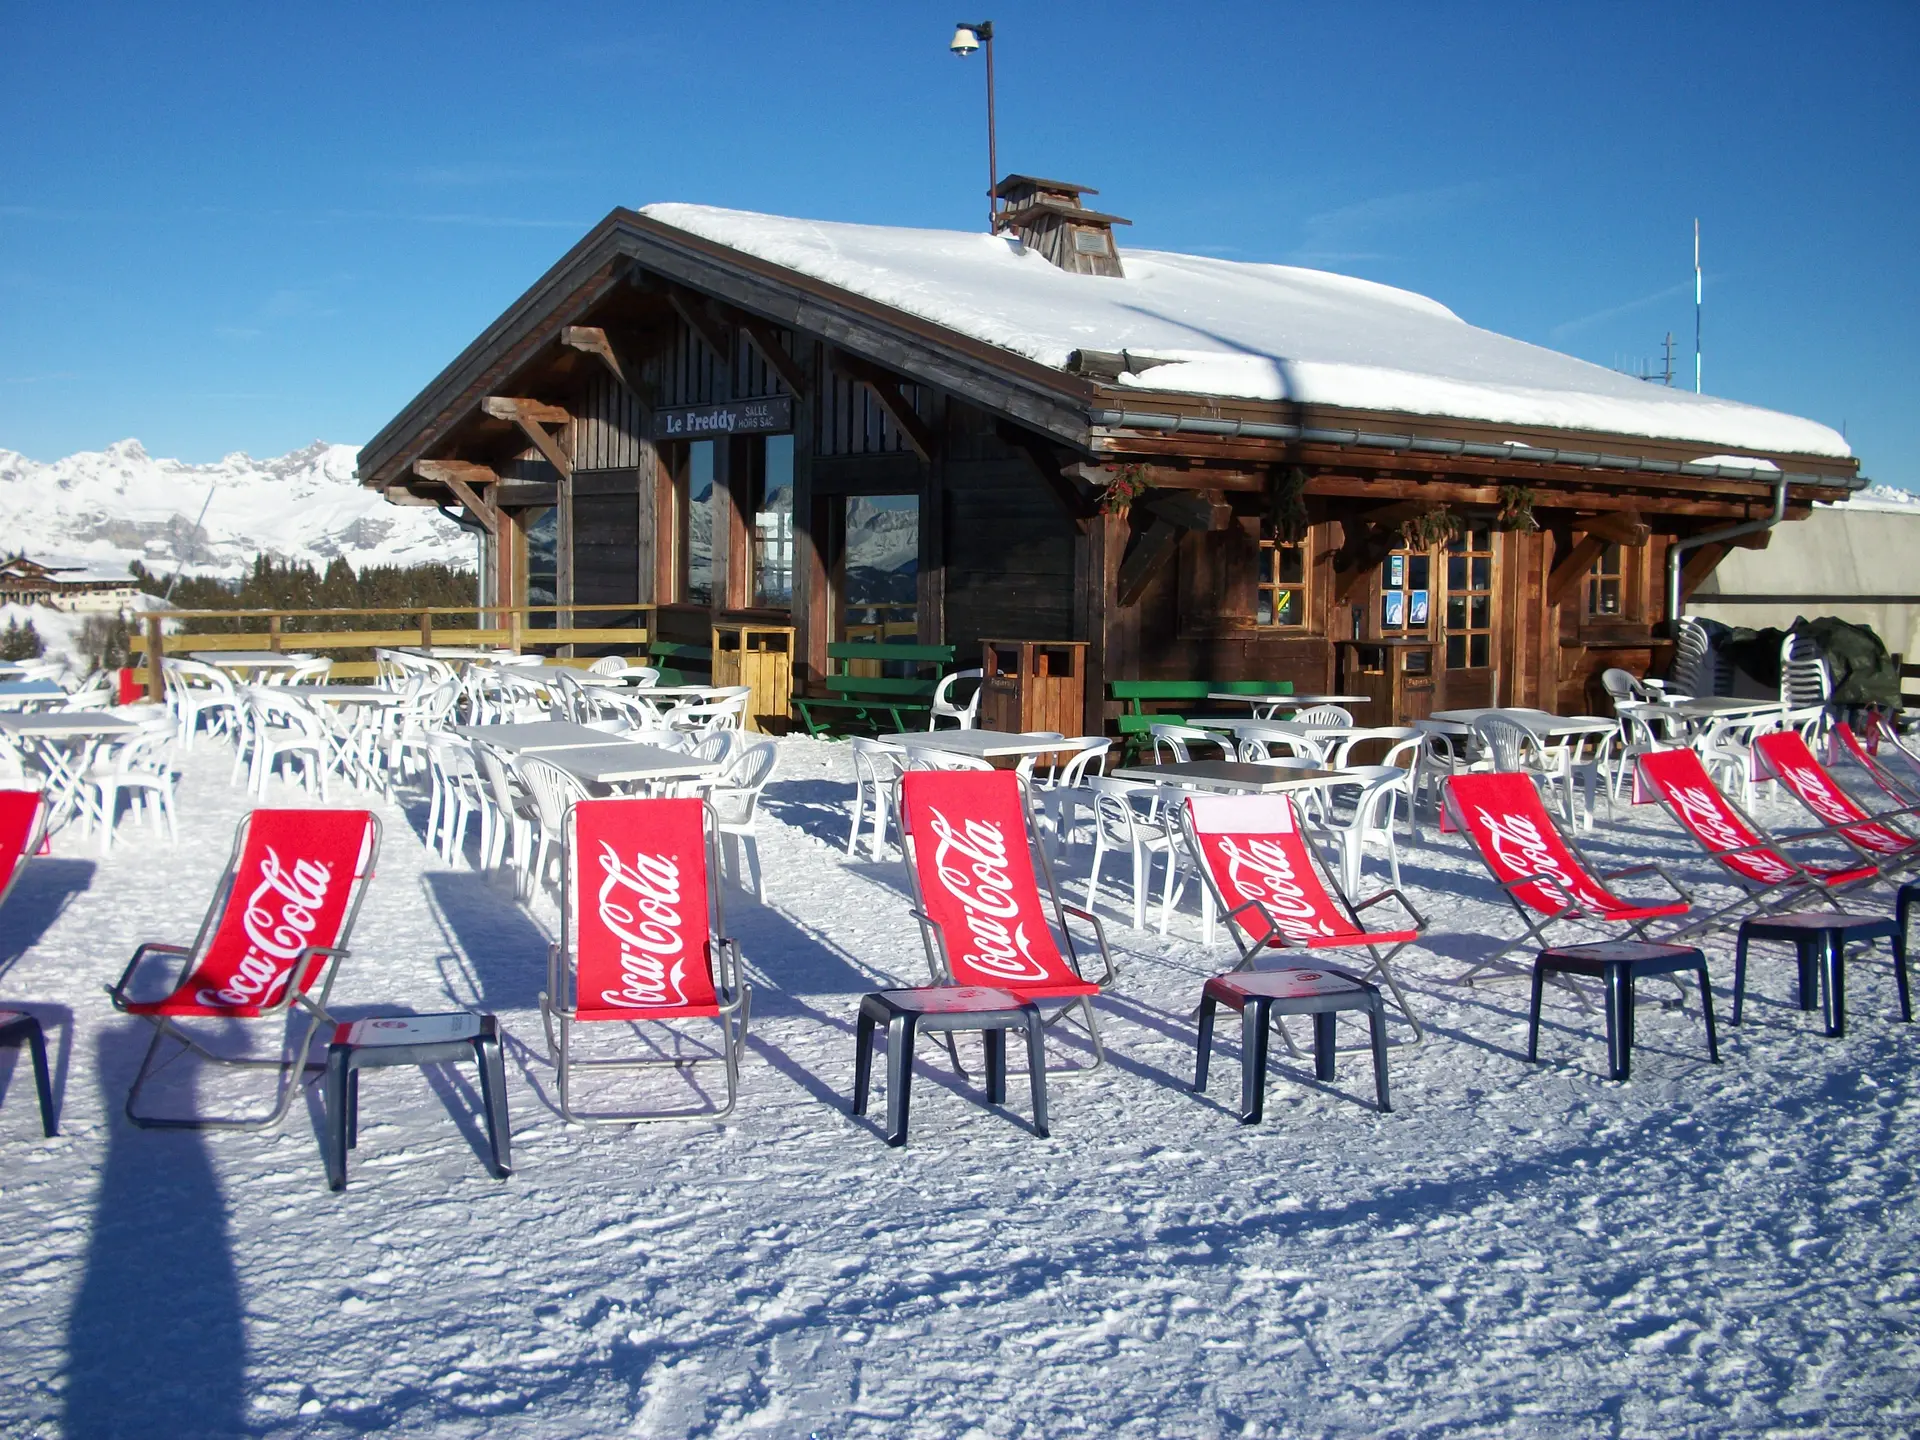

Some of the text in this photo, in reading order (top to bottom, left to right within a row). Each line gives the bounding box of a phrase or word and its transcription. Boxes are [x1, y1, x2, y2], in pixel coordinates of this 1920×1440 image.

[666, 410, 736, 433] Le Freddy
[739, 416, 774, 429] HORS SAC
[745, 404, 768, 416] SALLE
[1474, 804, 1616, 914] ca-Cola
[1663, 779, 1797, 882] caCola
[195, 844, 332, 1008] Coca-Cola
[598, 839, 688, 1007] Coca-Cola
[928, 805, 1049, 981] Coca-Cola
[1218, 836, 1335, 939] ca-Cola
